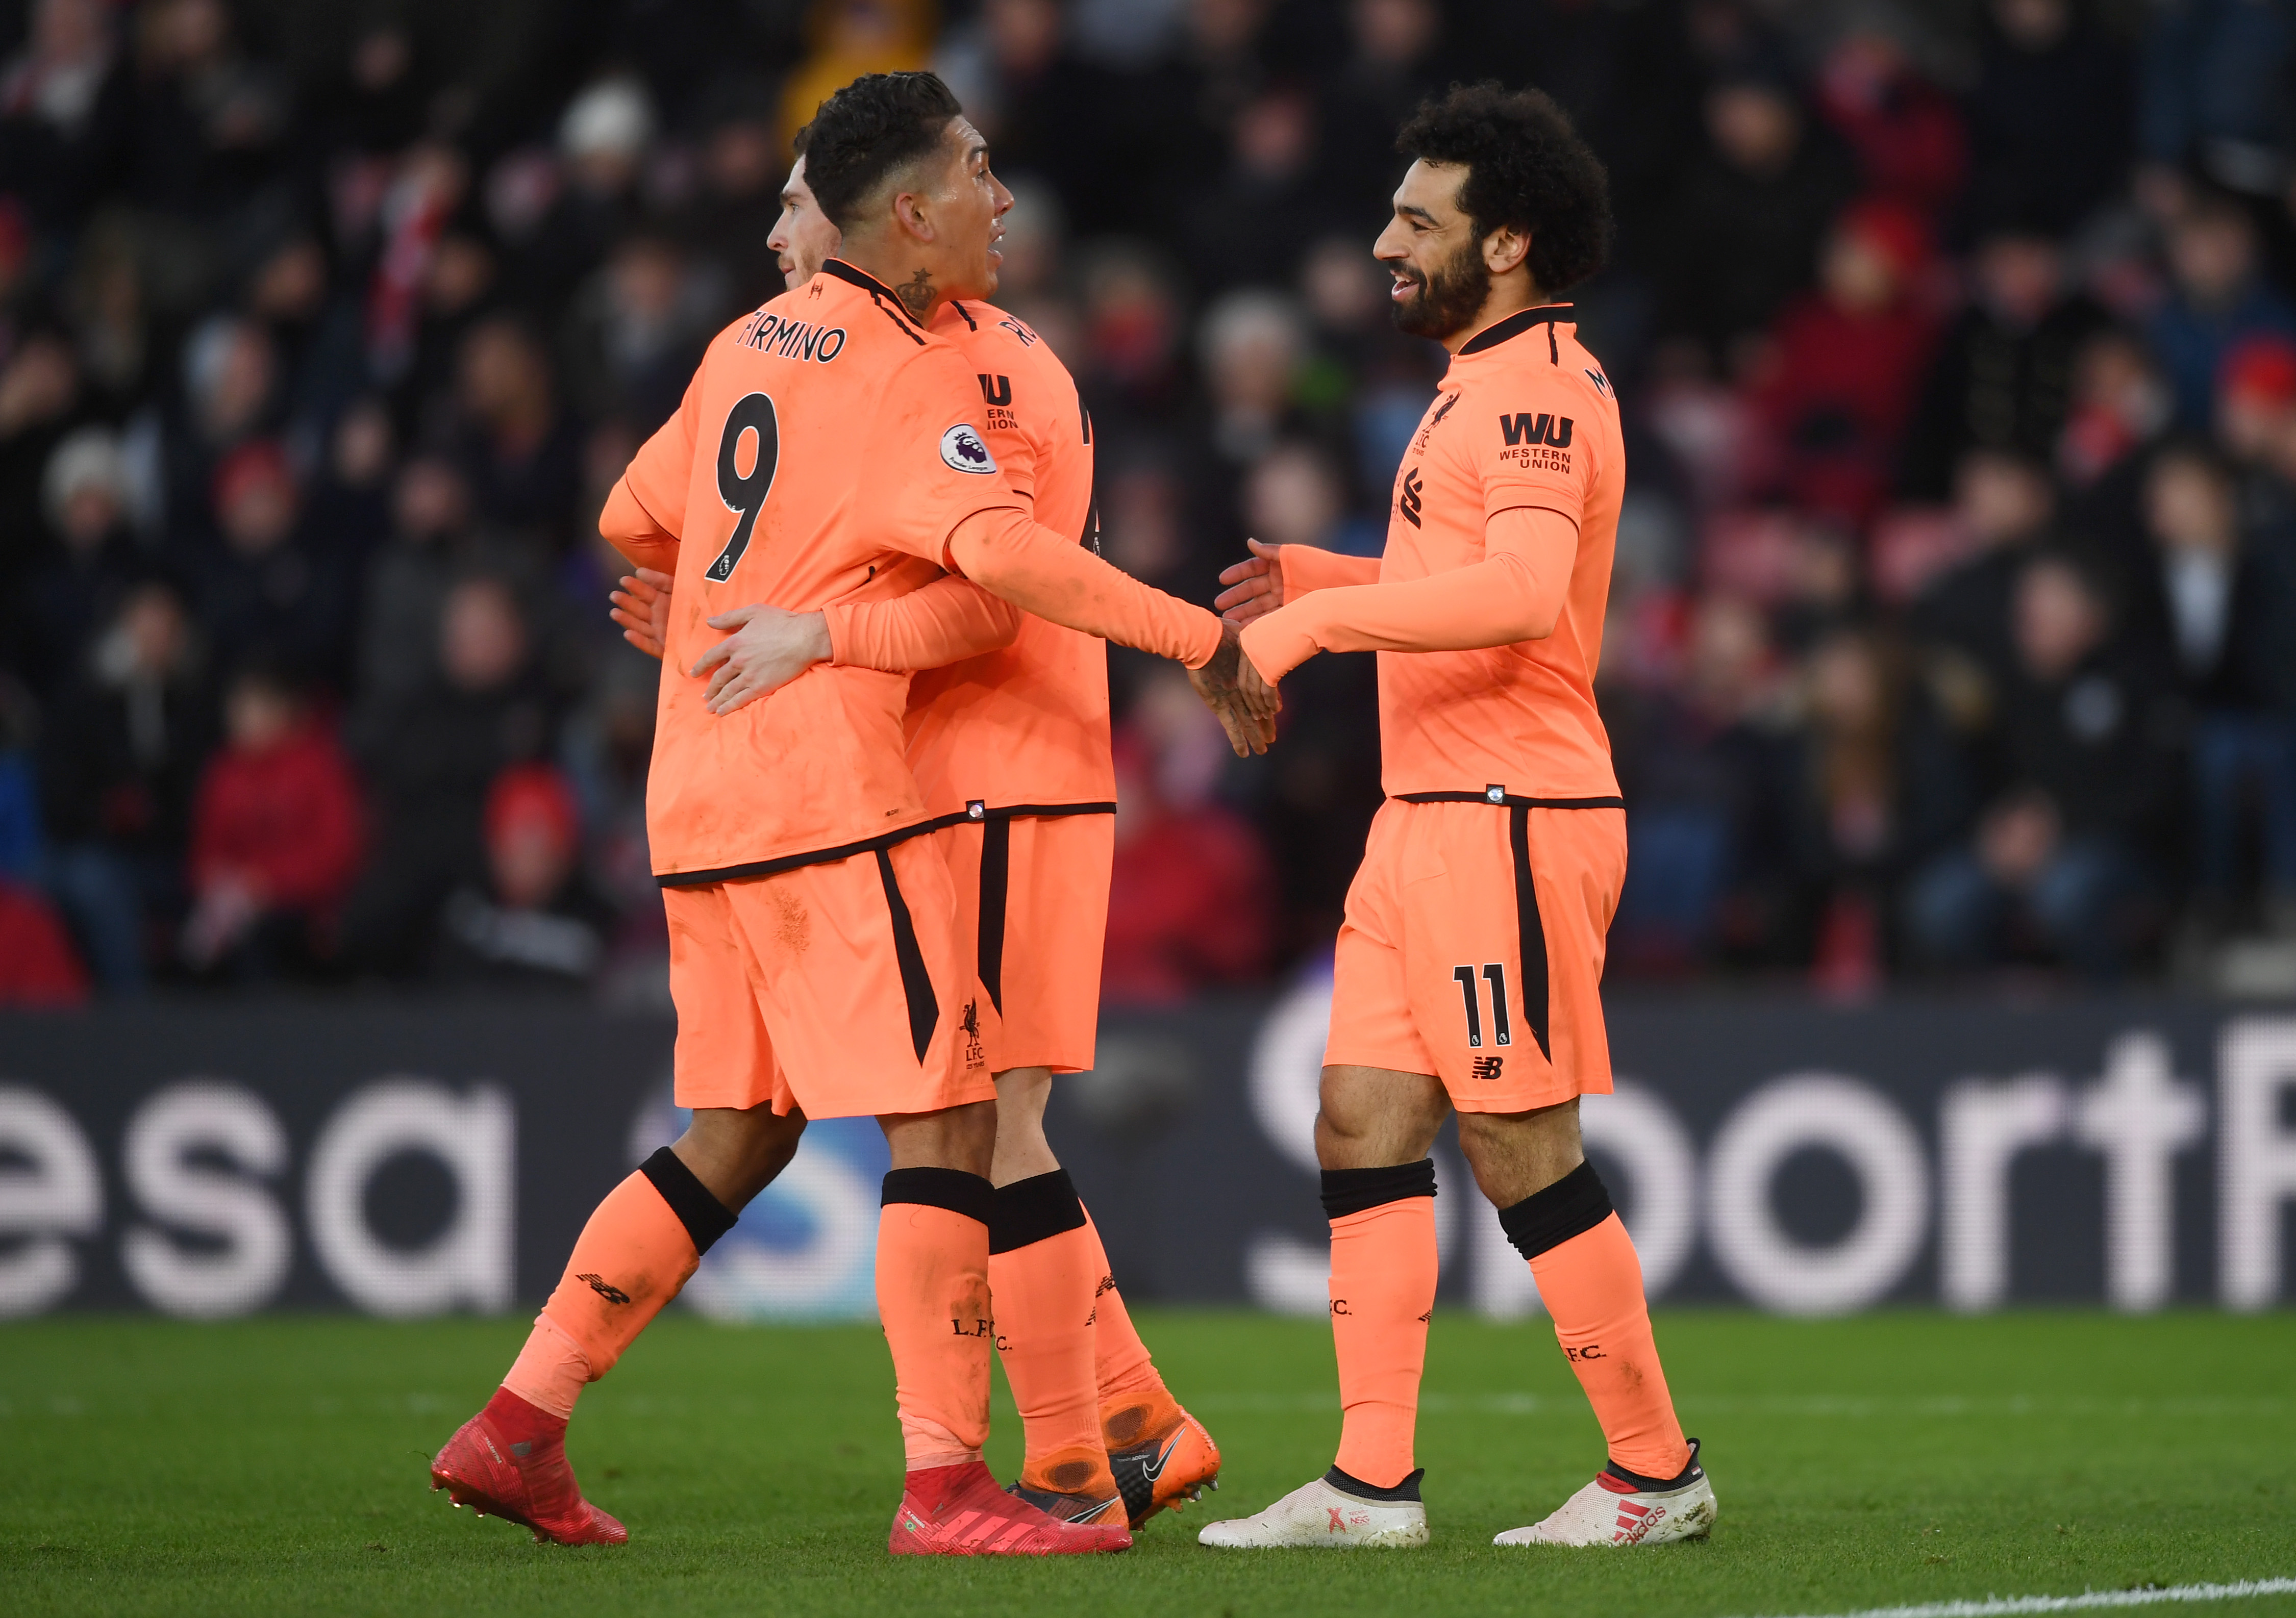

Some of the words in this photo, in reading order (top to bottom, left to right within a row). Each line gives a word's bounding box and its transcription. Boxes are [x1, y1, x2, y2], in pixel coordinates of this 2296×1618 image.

[735, 310, 847, 364] FIRMINO
[1499, 413, 1575, 448] WU
[1500, 448, 1571, 464] WESTERN
[1519, 459, 1570, 474] UNION
[704, 391, 780, 584] 9
[1453, 963, 1512, 1049] 11
[966, 1047, 985, 1061] LFC
[1624, 1506, 1666, 1546] didas
